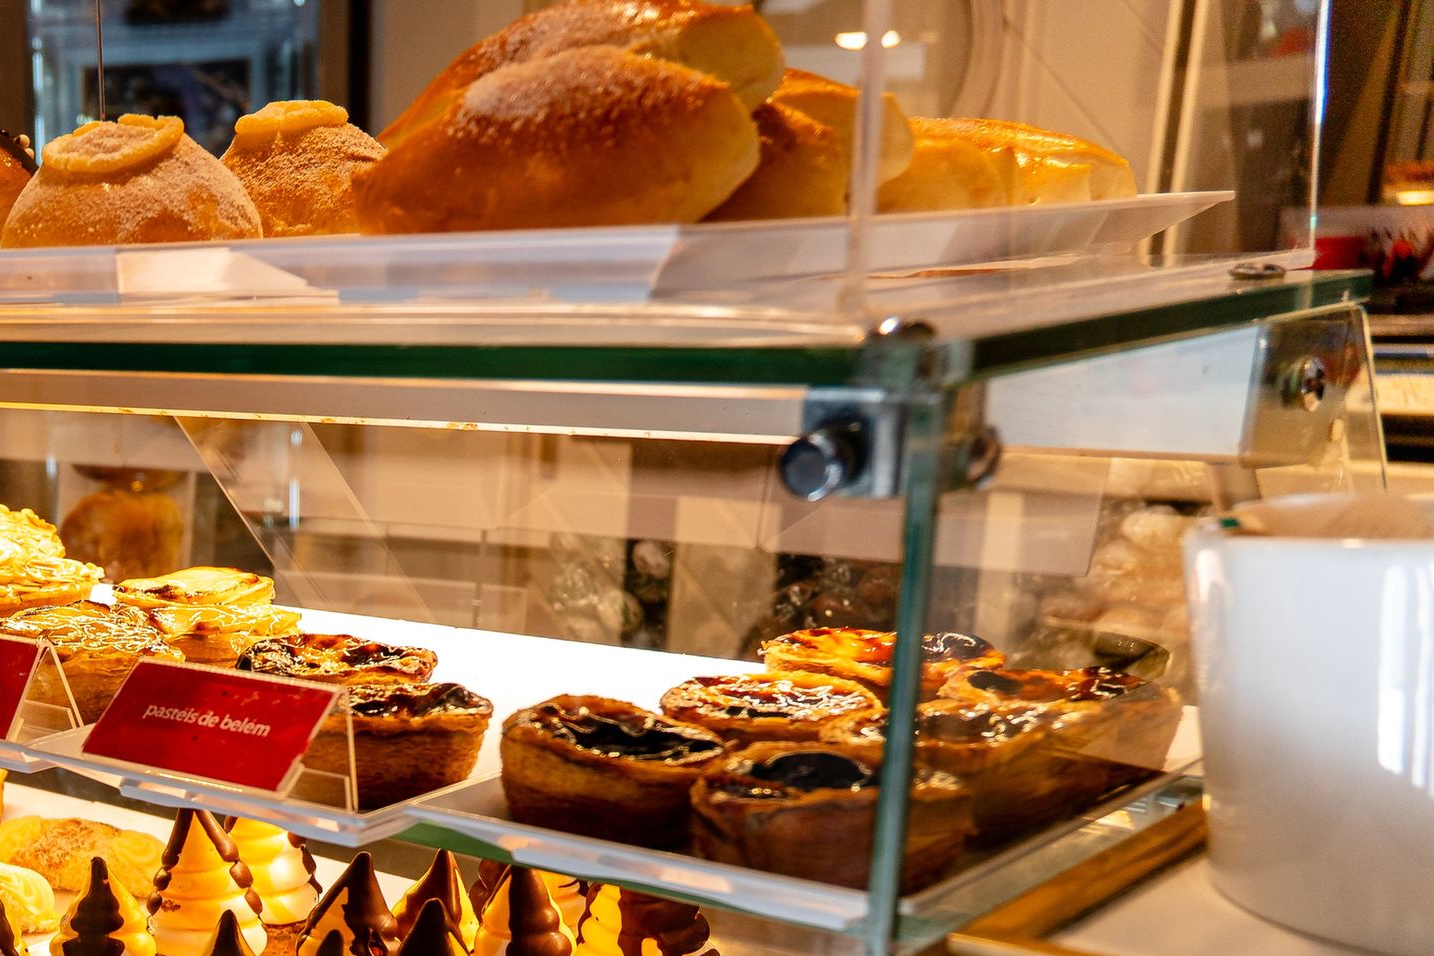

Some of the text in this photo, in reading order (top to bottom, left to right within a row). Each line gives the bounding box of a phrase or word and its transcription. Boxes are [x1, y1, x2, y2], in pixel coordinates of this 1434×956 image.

[142, 703, 271, 738] pastéis de belém
